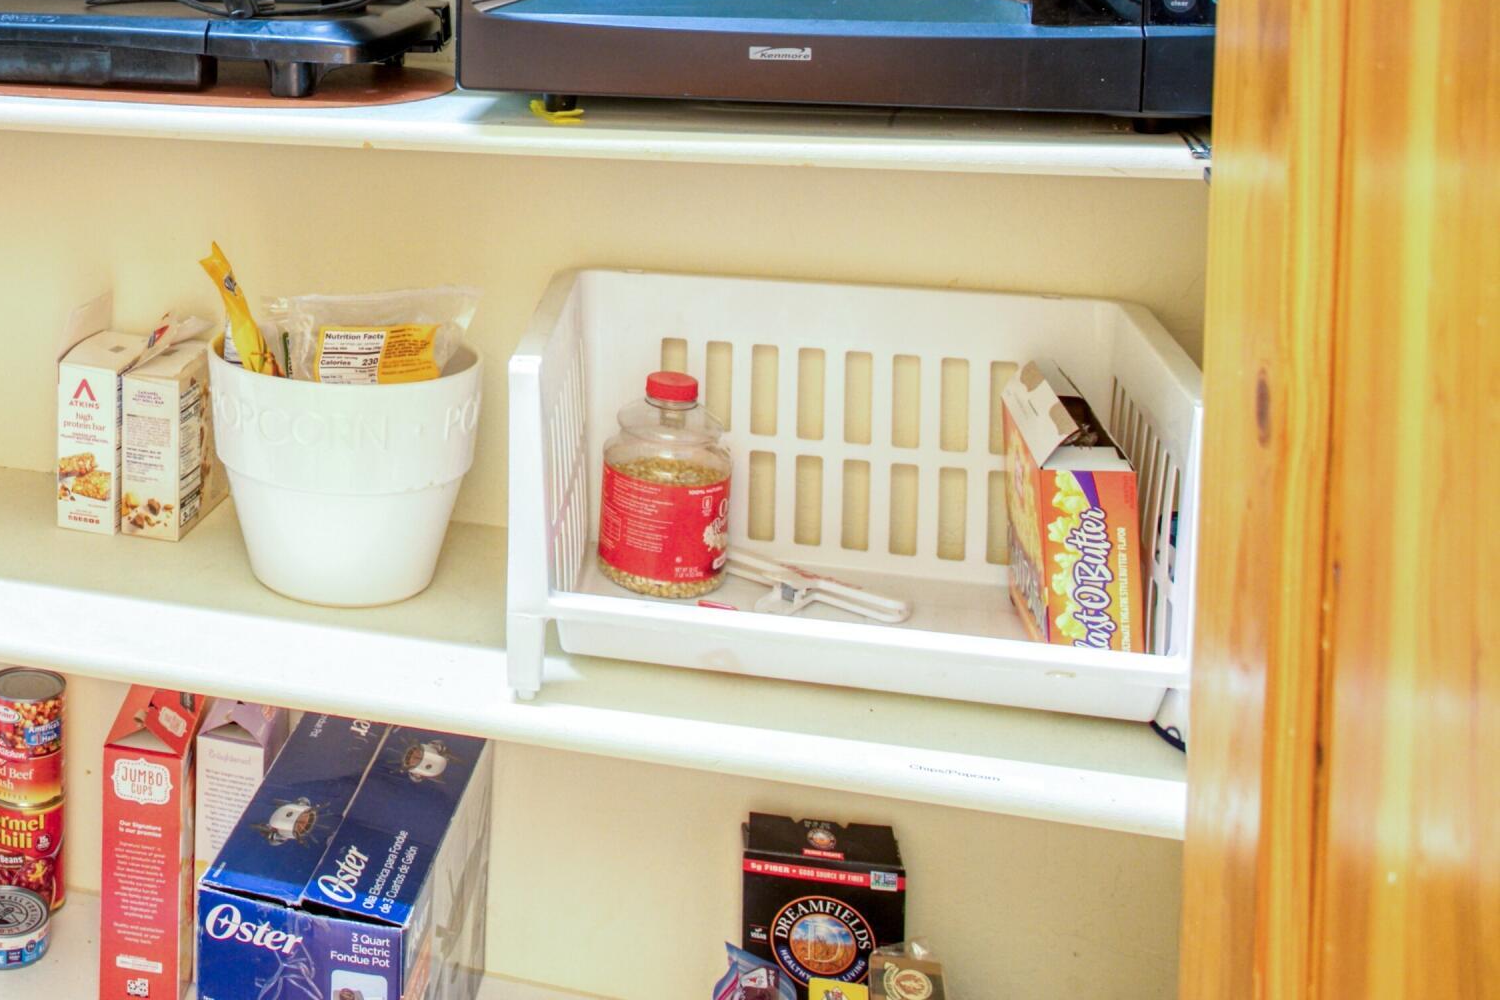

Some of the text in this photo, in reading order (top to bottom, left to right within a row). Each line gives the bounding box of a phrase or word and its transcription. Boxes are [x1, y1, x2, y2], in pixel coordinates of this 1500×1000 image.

[325, 333, 361, 341] Nutrition
[361, 358, 379, 366] 230
[69, 400, 100, 410] ATKINS
[76, 412, 93, 422] high
[63, 420, 105, 431] protein bar
[1066, 506, 1114, 585] Butter
[1116, 528, 1127, 550] FLAVOR
[9, 767, 35, 780] Beef
[121, 766, 163, 787] JUMBO
[131, 782, 153, 796] CUPS
[132, 822, 161, 832] Signature
[388, 830, 408, 855] Fondue
[0, 854, 23, 864] Beans
[384, 853, 398, 870] para
[317, 846, 369, 903] Oster
[764, 863, 790, 874] FIBER
[798, 868, 815, 877] GOOD
[816, 871, 837, 880] SOURCE
[847, 875, 864, 883] FIBER
[379, 903, 393, 914] de
[386, 874, 406, 898] Cuartos
[398, 864, 410, 874] de
[362, 895, 378, 909] Olla
[205, 904, 304, 955] Oster
[775, 899, 871, 950] DREAMFIELDS
[351, 932, 390, 946] 3 Quart
[352, 944, 390, 957] Electric
[330, 951, 390, 967] Fondue Pot
[780, 949, 866, 982] HEALTHY LIVING
